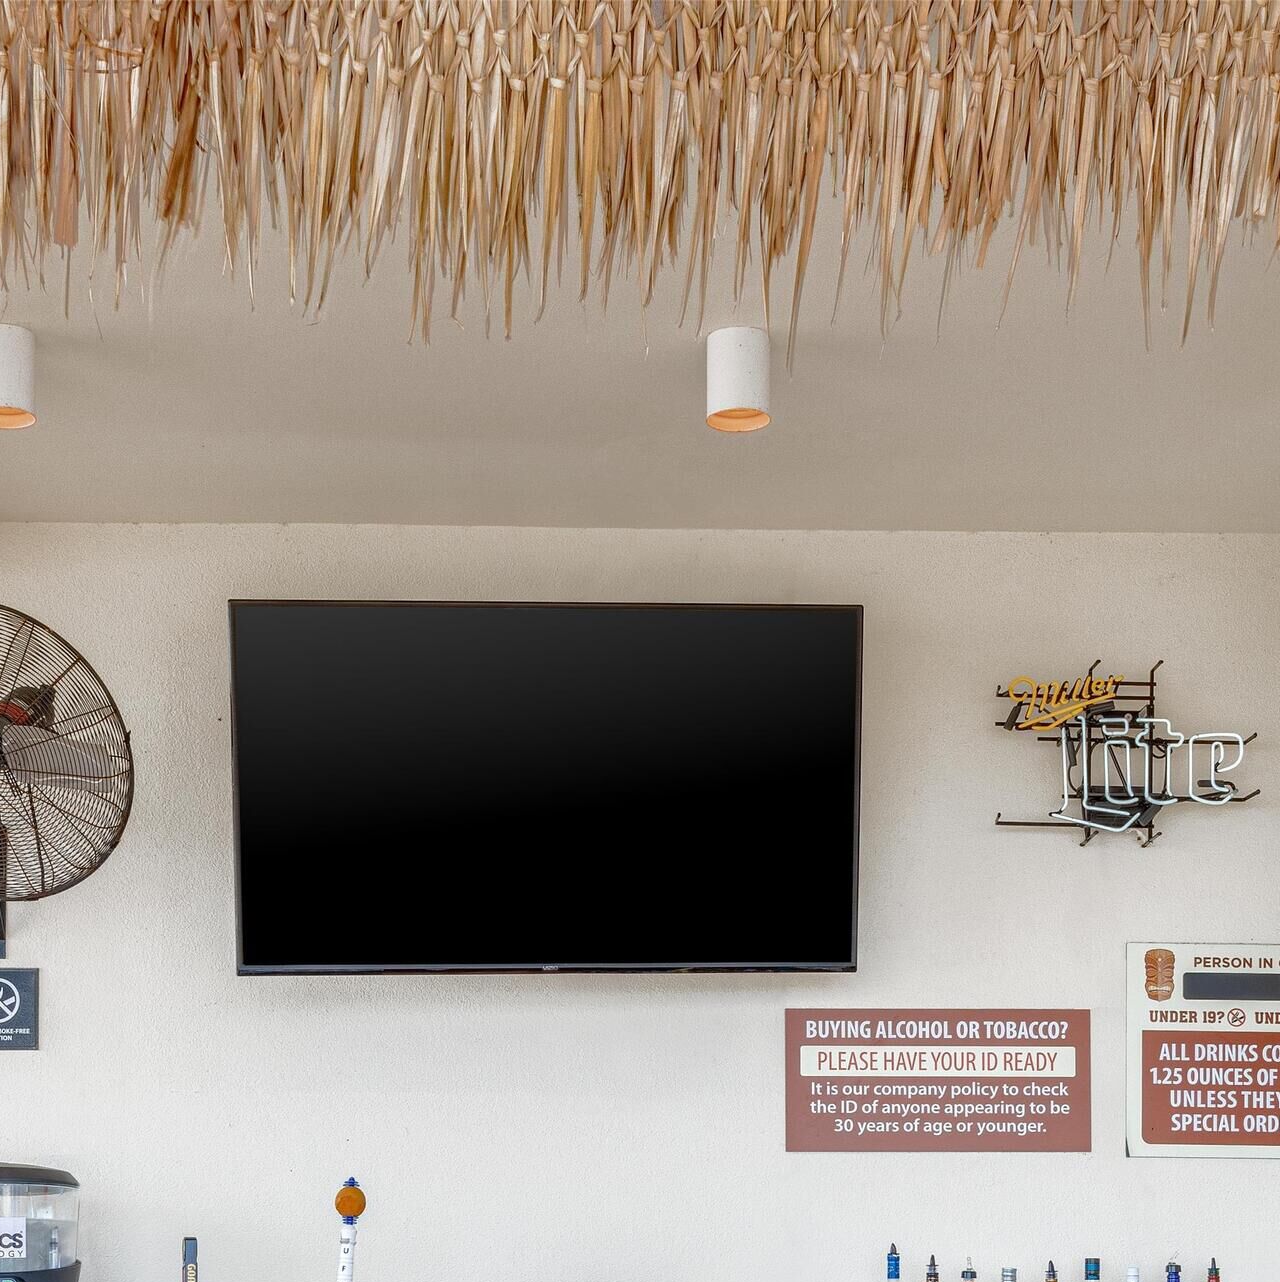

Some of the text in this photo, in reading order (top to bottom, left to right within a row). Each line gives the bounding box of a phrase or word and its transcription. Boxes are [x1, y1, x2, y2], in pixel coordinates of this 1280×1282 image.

[1008, 675, 1124, 720] Miller
[1193, 956, 1253, 969] PERSON
[1258, 957, 1273, 969] IN
[1149, 1010, 1198, 1024] UNDER
[1202, 1010, 1226, 1024] 19?
[806, 1020, 1069, 1040] BUYING ALCOHOL OR TOBACCO?
[817, 1051, 1058, 1072] PLEASE HAVE YOUR ID READY
[1159, 1043, 1190, 1061] ALL
[1194, 1043, 1259, 1063] DRINKS
[1149, 1067, 1183, 1085] 1.25
[1186, 1067, 1254, 1086] OUNCES
[1256, 1068, 1278, 1086] OF
[811, 1081, 1069, 1100] It is our company policy to check
[1169, 1089, 1238, 1109] UNLESS
[809, 1099, 1071, 1118] the ID of anyone appearing to be
[834, 1118, 1047, 1136] 30 years of age or younger.
[1170, 1113, 1240, 1132] SPECIAL
